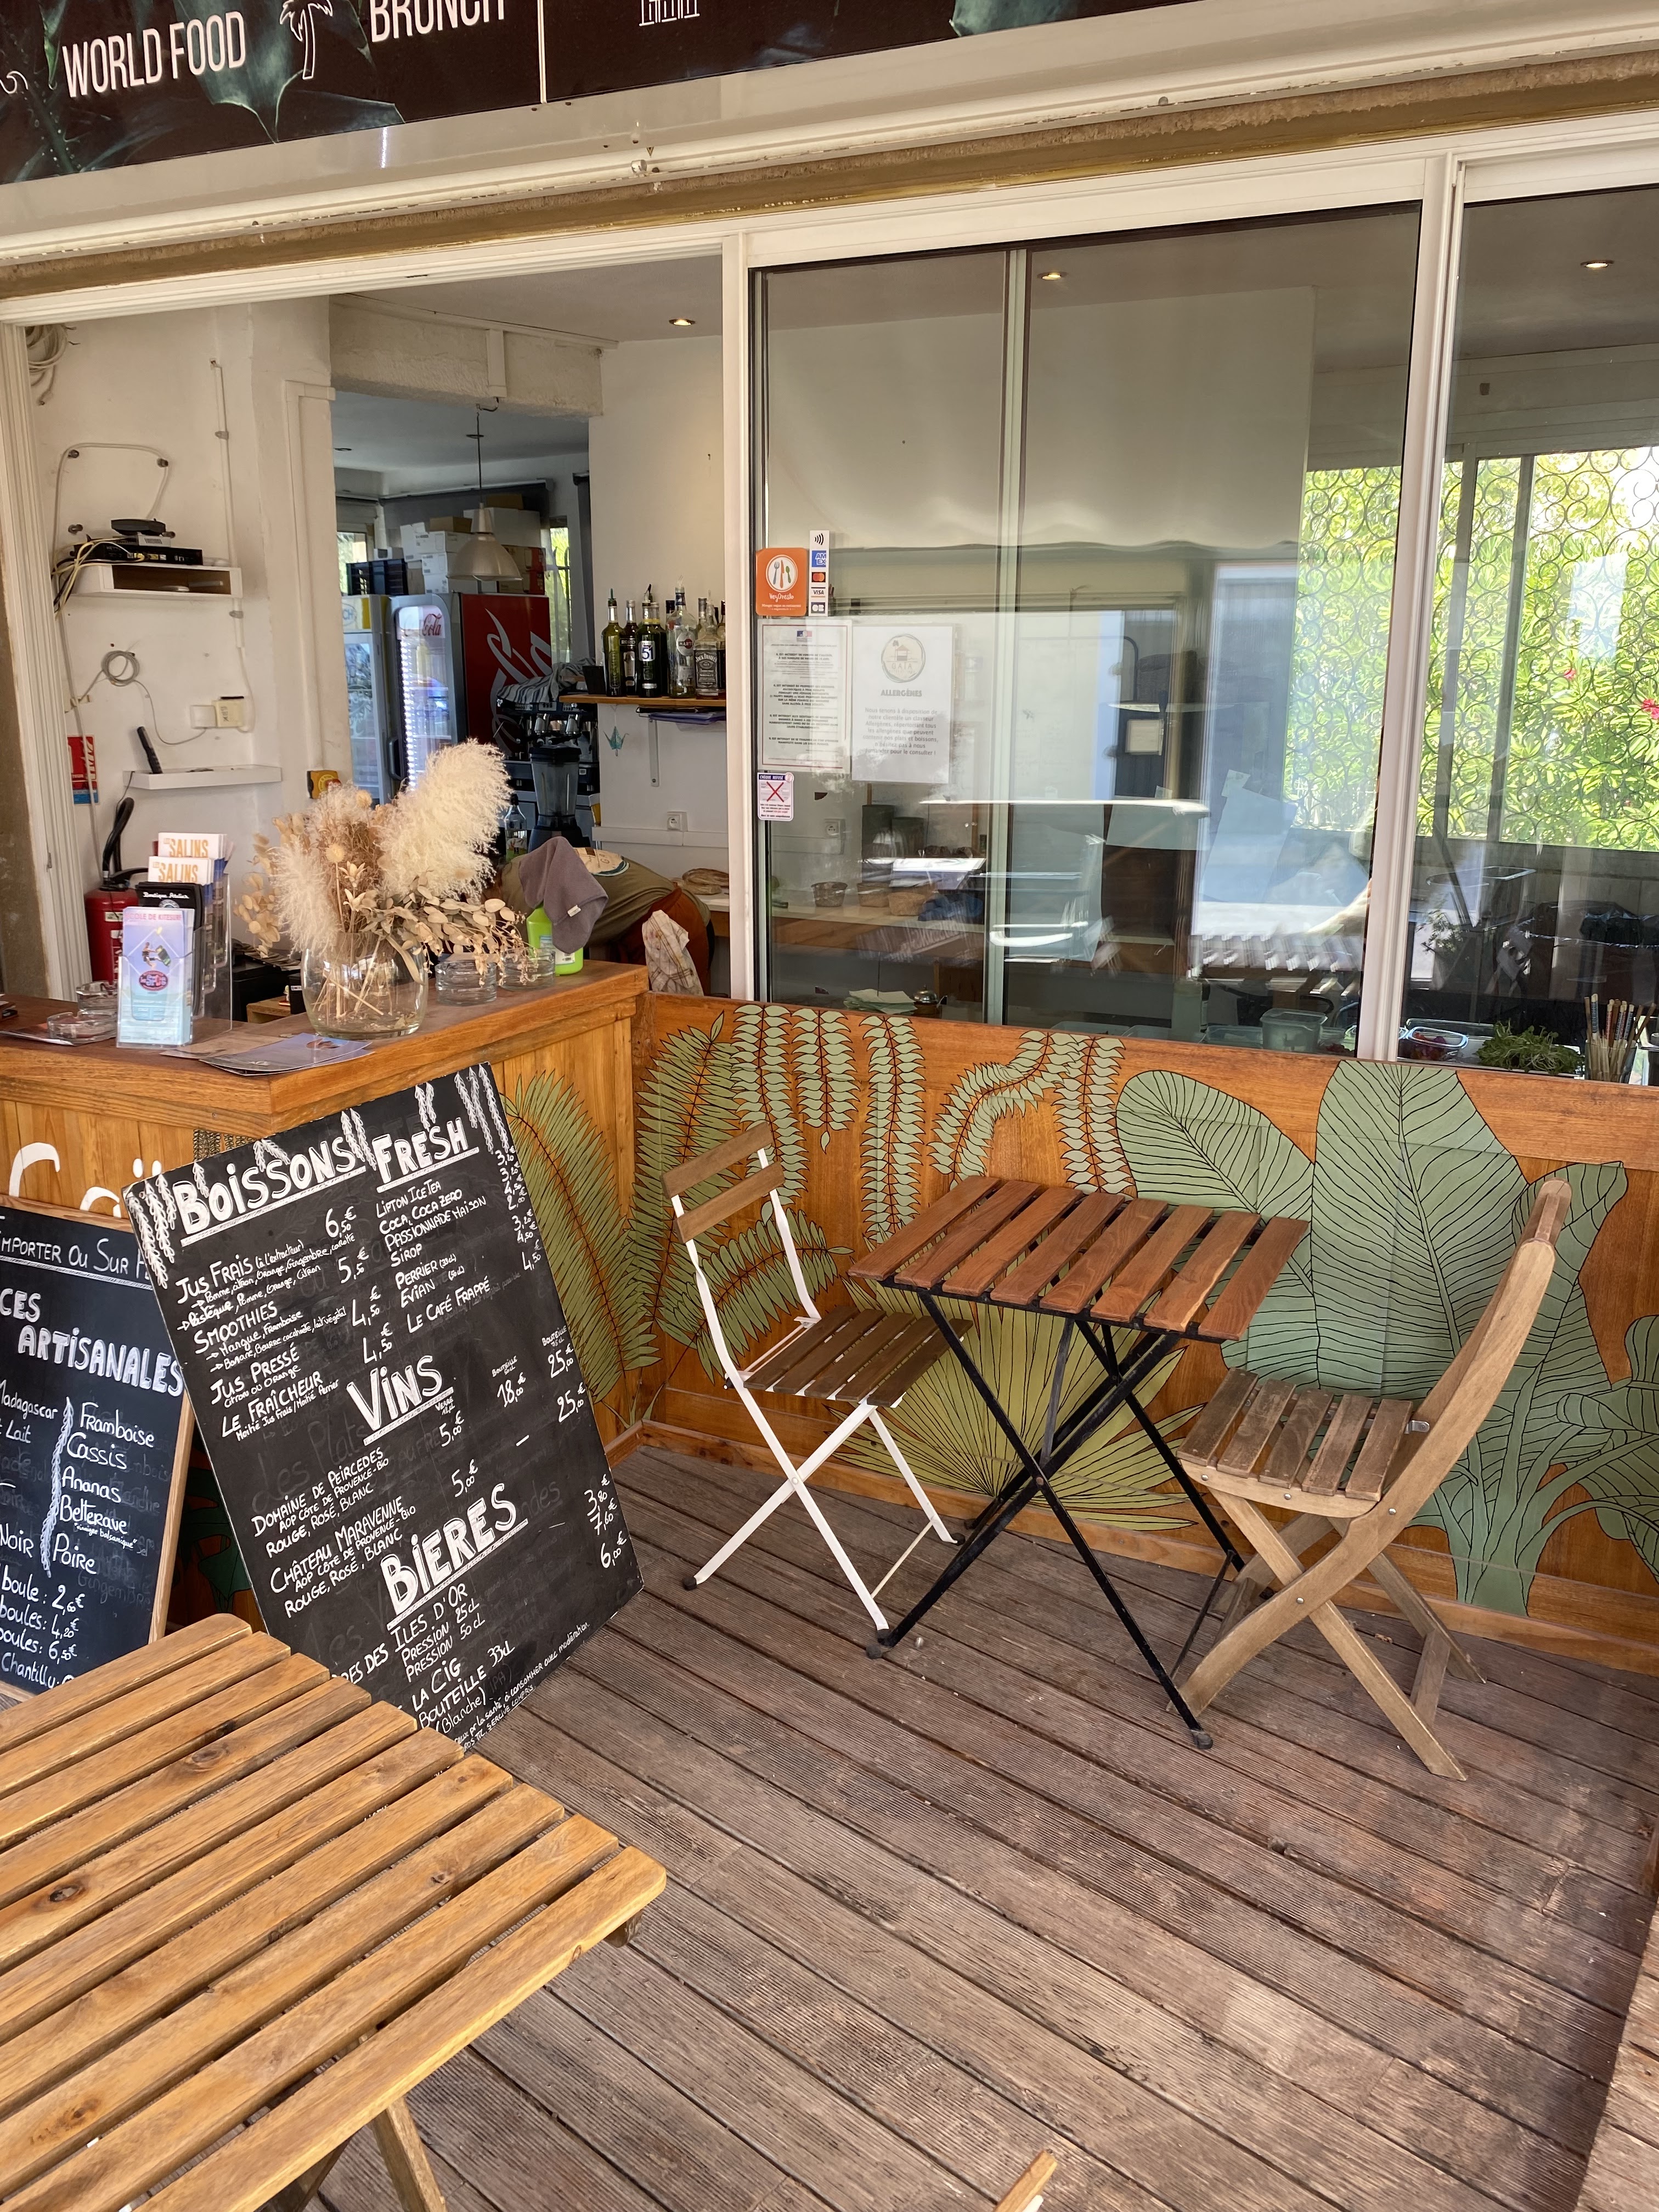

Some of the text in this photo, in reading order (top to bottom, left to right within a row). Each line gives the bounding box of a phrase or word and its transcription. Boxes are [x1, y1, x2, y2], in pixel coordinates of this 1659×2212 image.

[62, 11, 246, 98] WORLD FOOD
[641, 645, 653, 660] 51
[881, 689, 922, 697] ALLERGÈNES
[170, 838, 208, 857] SALINS
[159, 862, 198, 883] SALINS
[371, 1117, 469, 1184] FRESH
[411, 1201, 439, 1220] COCA
[438, 1188, 463, 1208] ZERO
[1, 1237, 61, 1263] MPORTER
[93, 1238, 128, 1274] SUR
[426, 1294, 453, 1322] CAFÉ
[454, 1274, 491, 1306] FRAPPÉ
[194, 1300, 278, 1355] SMOOTHIES
[18, 1325, 184, 1397] ARTISANALES
[346, 1355, 443, 1431] VINS
[5, 1419, 31, 1444] Lait
[80, 1402, 154, 1448] Framboise
[66, 1432, 127, 1470] Cassis
[61, 1466, 122, 1504] Ananas
[311, 1482, 325, 1500] DE
[339, 1482, 374, 1512] BLANC
[59, 1494, 128, 1534] Betterave
[279, 1515, 297, 1534] AOP
[321, 1493, 334, 1507] DE
[270, 1544, 332, 1593] CHÂTEAU
[334, 1496, 404, 1553] MARAVENNE
[364, 1527, 403, 1561] BLANC
[295, 1571, 313, 1593] AOP
[342, 1547, 355, 1561] DE
[364, 1643, 389, 1674] DES
[401, 1621, 449, 1668] PRESSION
[405, 1637, 454, 1683] PRESSION
[411, 1688, 430, 1712] LA
